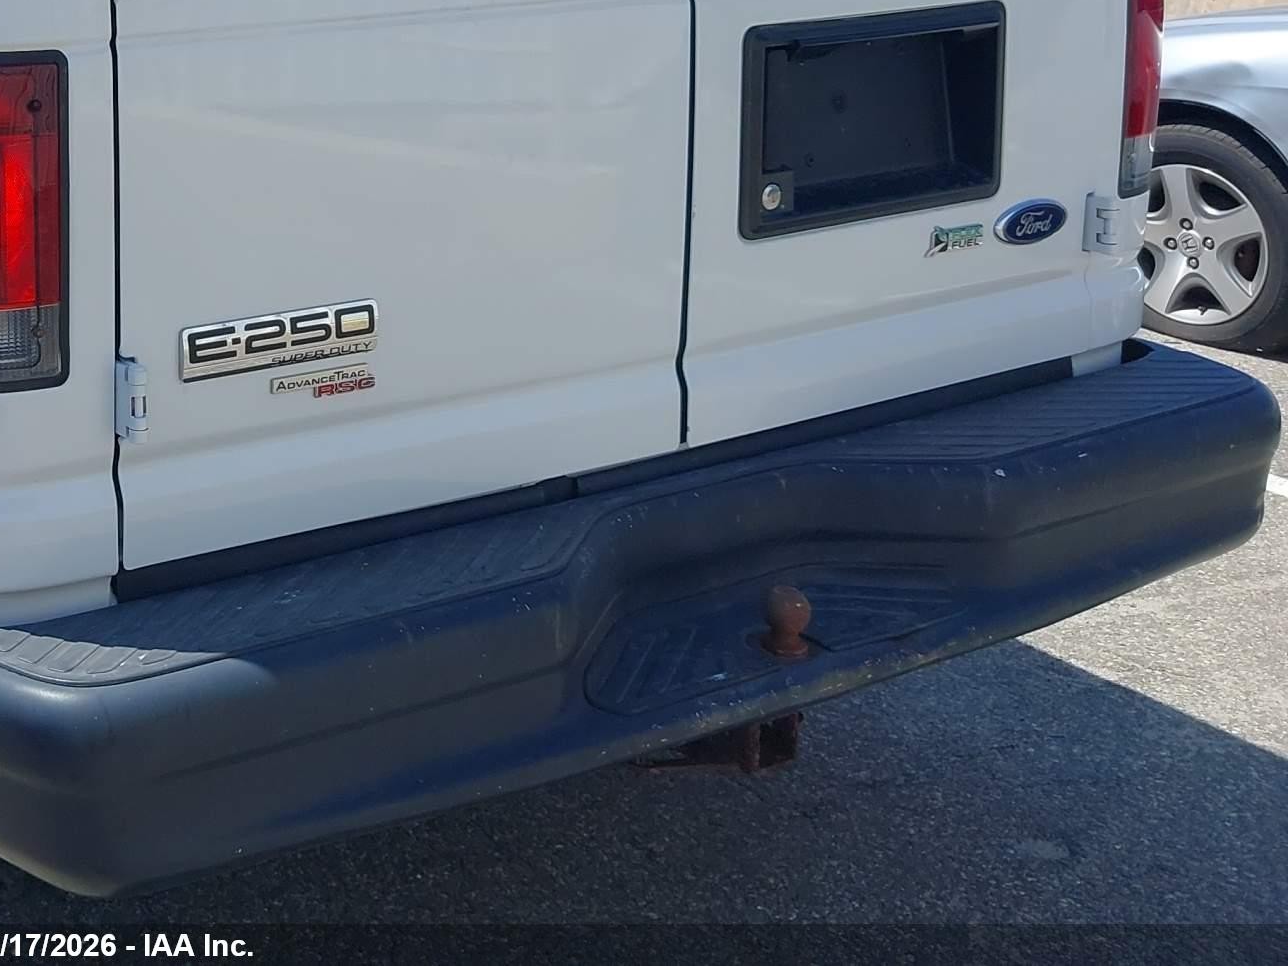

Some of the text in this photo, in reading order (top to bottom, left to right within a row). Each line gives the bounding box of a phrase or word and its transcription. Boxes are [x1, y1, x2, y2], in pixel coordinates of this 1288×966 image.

[1015, 210, 1053, 237] Ford
[951, 236, 981, 250] FUEL
[187, 303, 375, 364] E-250
[271, 341, 373, 365] SUPER DUTY
